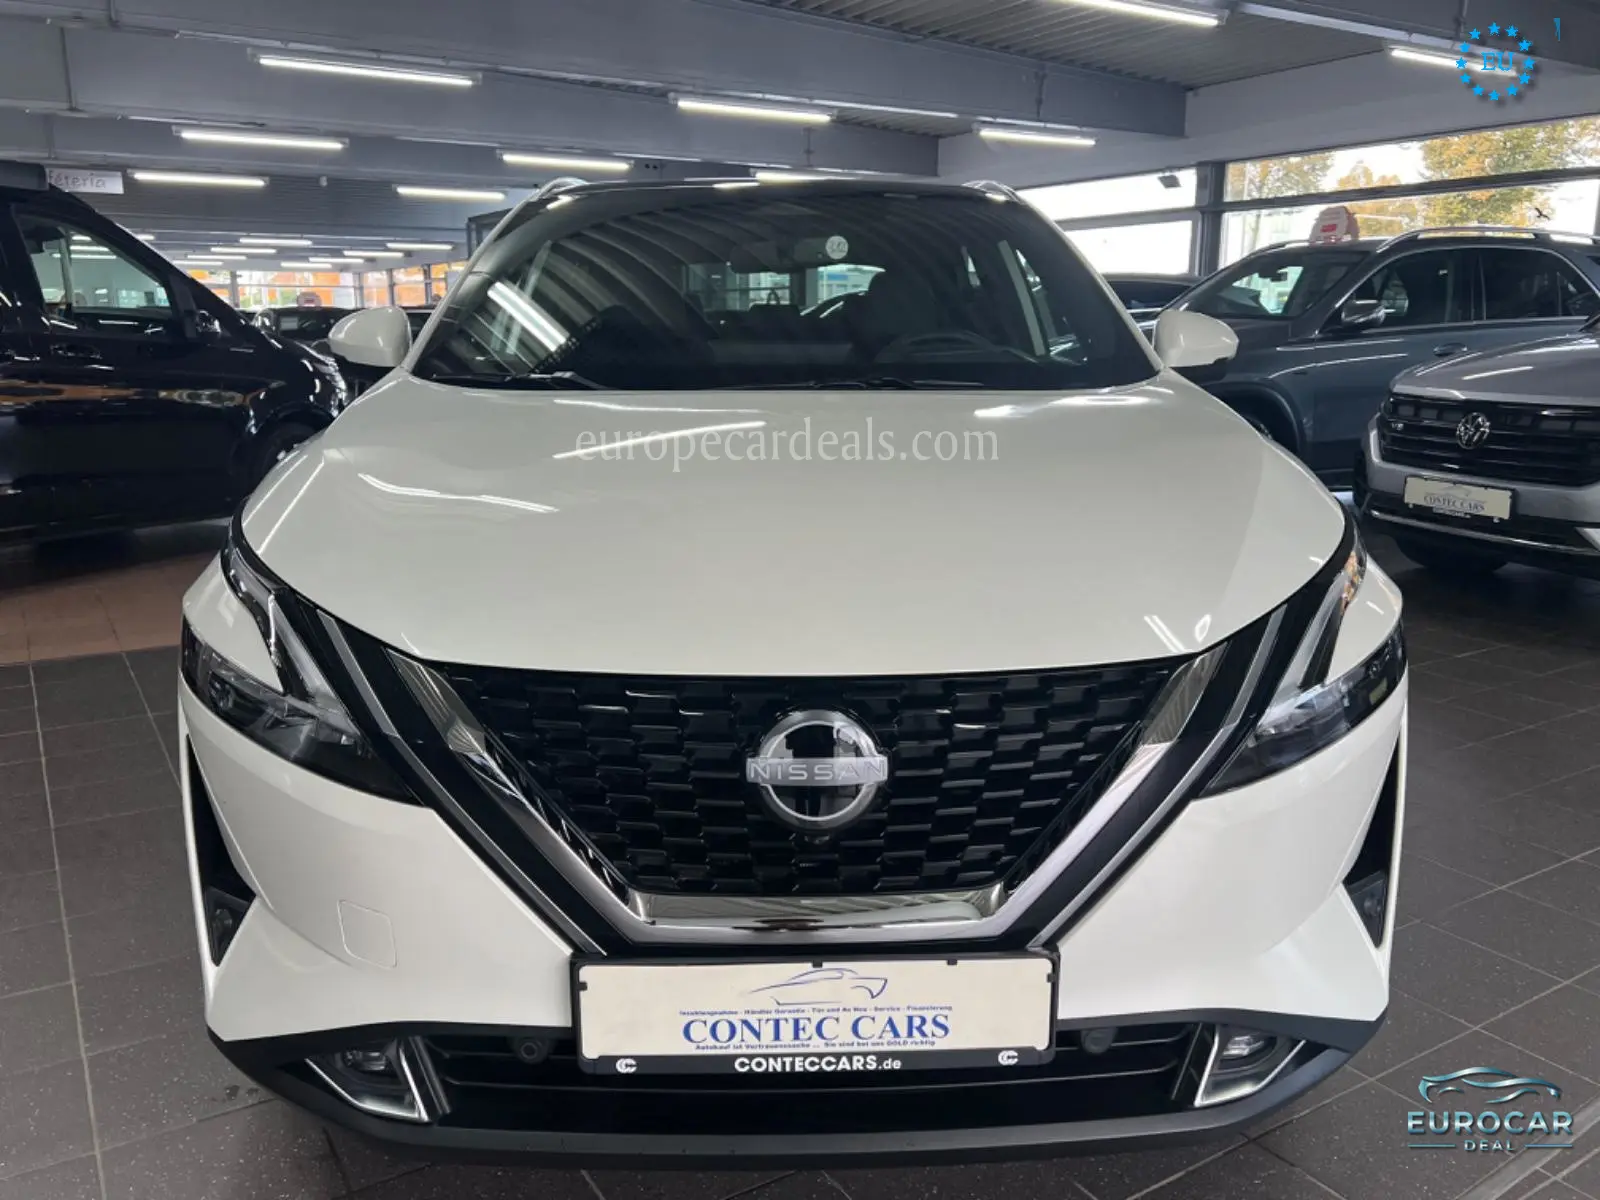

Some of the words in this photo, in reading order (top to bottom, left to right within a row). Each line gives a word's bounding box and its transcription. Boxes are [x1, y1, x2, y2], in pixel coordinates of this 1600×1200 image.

[750, 762, 885, 781] NISSAN
[683, 1016, 840, 1044] CONTEC
[851, 1014, 950, 1041] CARS
[734, 1055, 902, 1073] CONTECCARS.de
